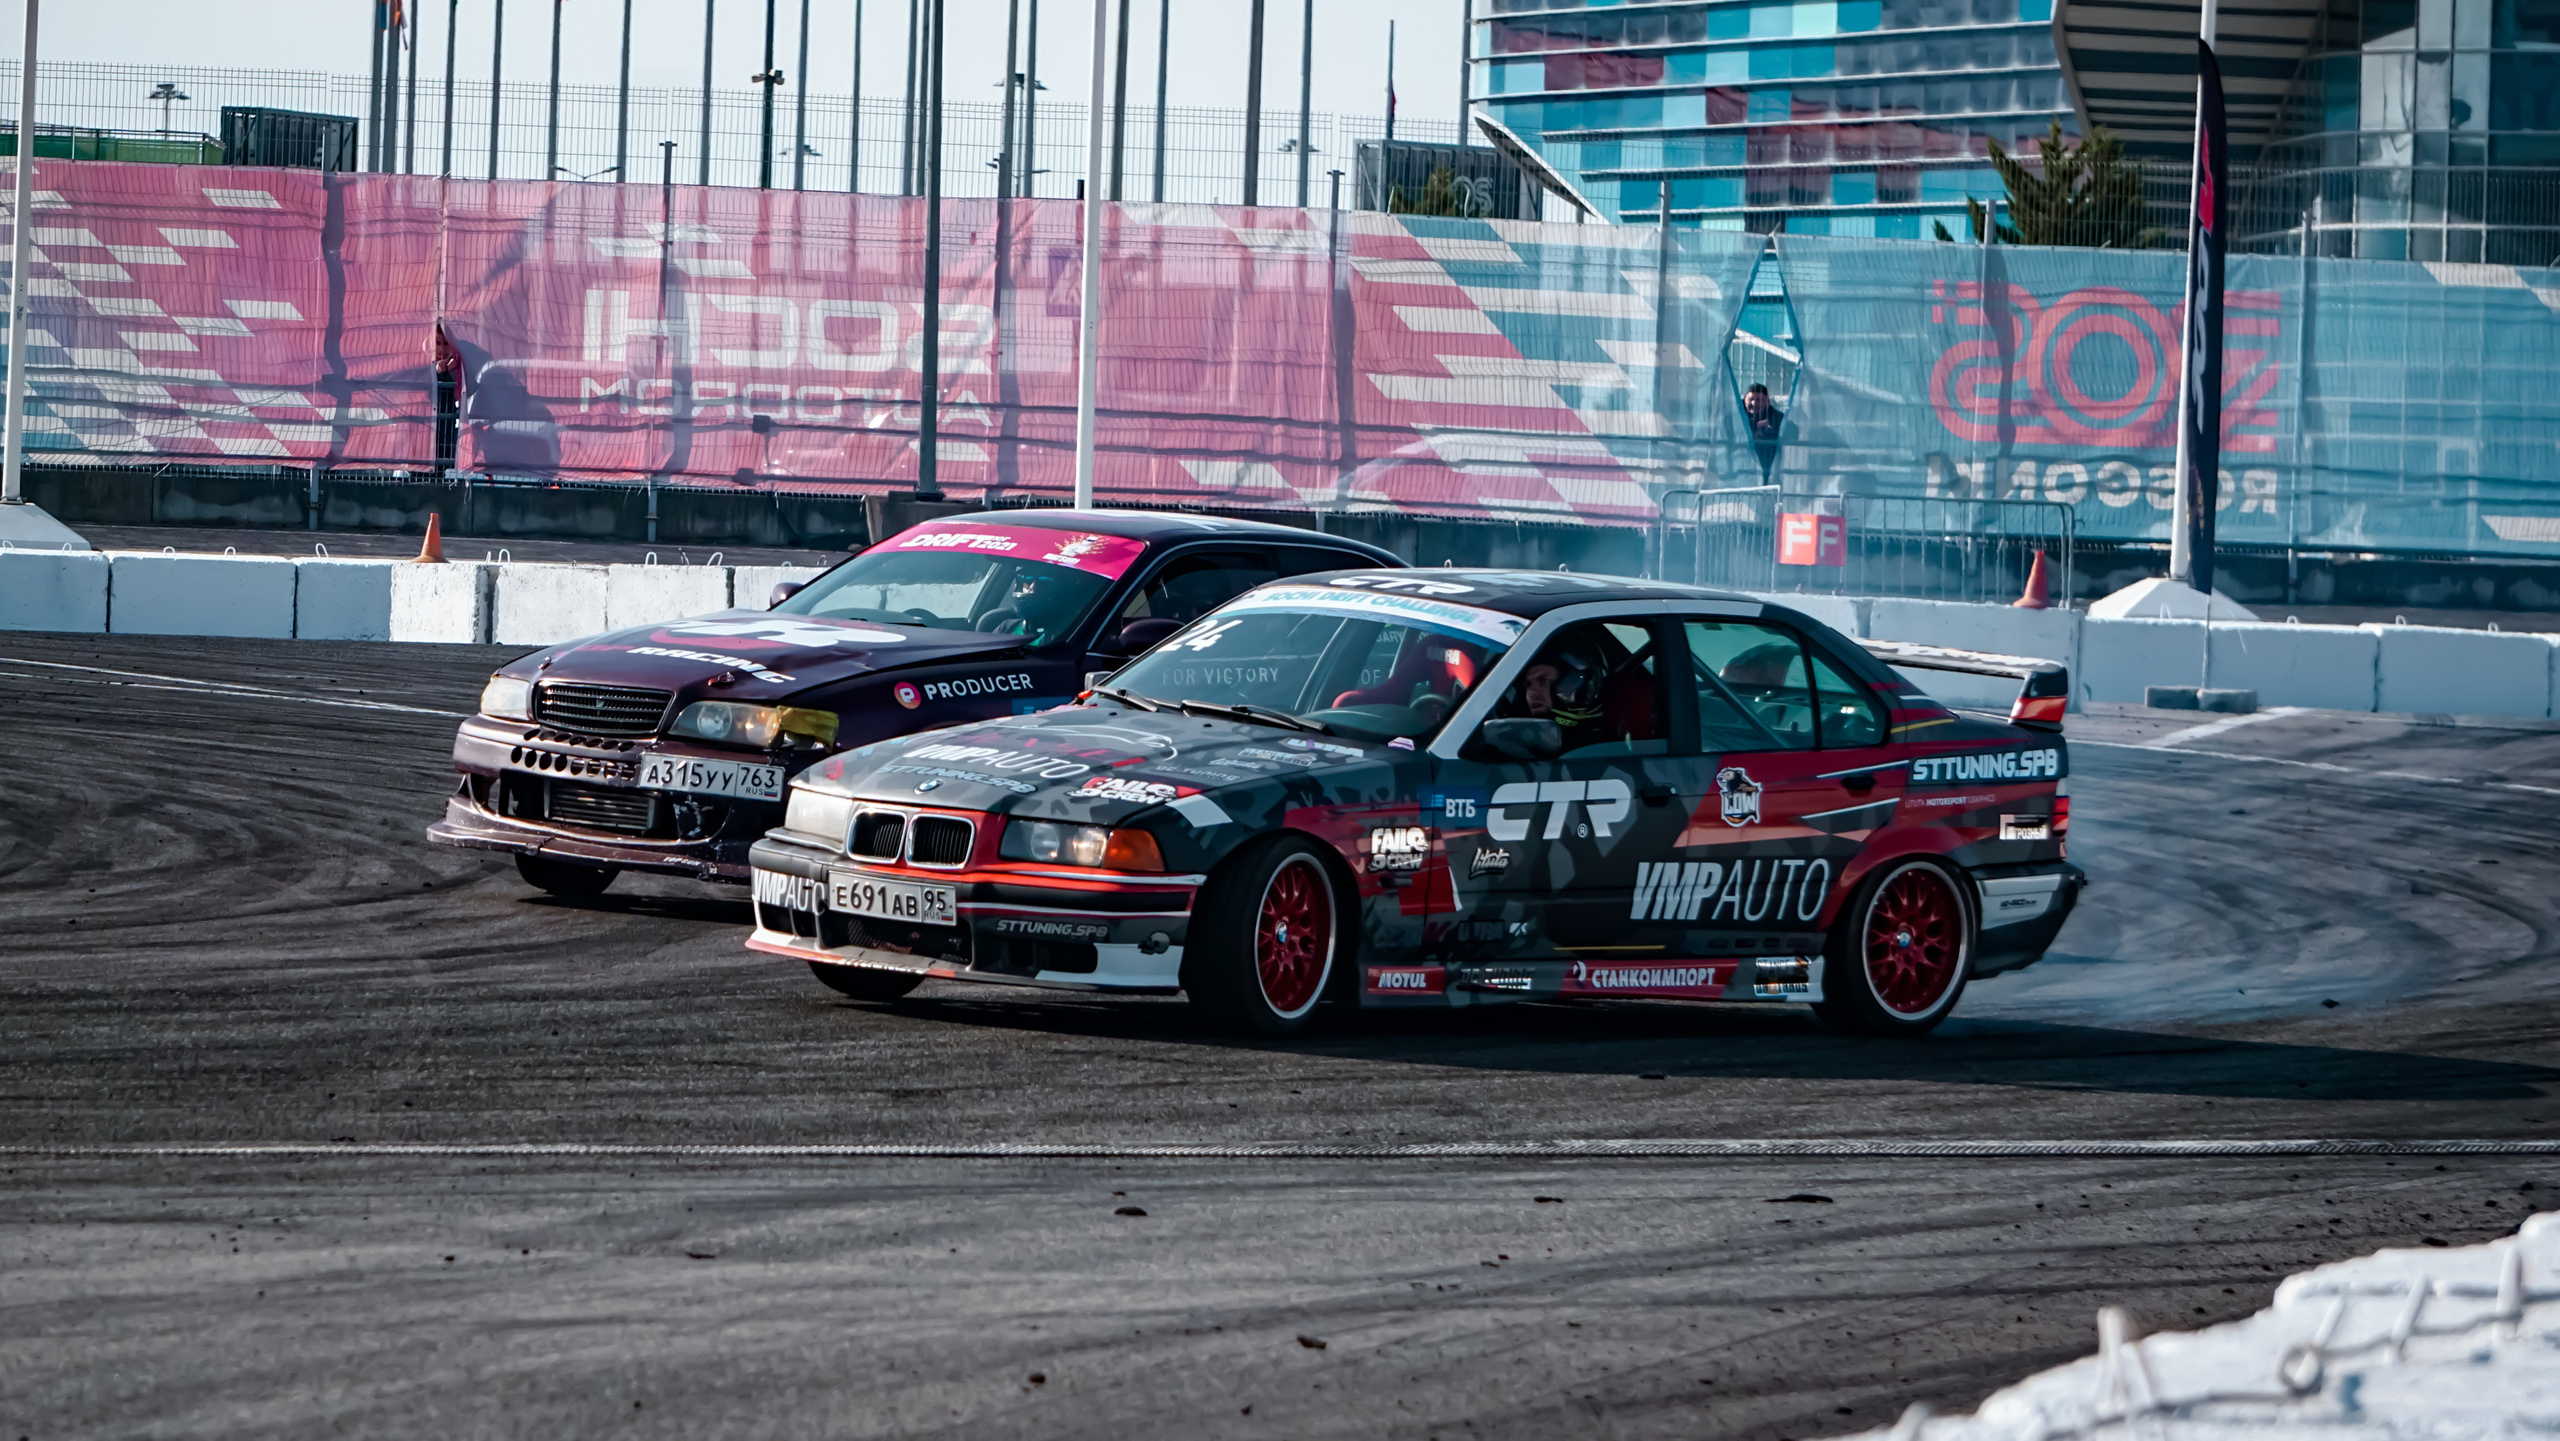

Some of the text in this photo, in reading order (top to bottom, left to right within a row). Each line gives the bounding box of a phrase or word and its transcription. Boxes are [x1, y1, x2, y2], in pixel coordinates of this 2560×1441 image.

[977, 540, 1018, 551] 2021
[1263, 590, 1481, 623] SOCHI DRIFT CHALLENGE
[627, 646, 796, 684] RACING
[923, 673, 1034, 701] PRODUCER
[1163, 668, 1196, 686] FOR
[1203, 667, 1279, 685] VICTORY
[905, 743, 1090, 779] VMPAUTO
[1912, 748, 2058, 781] STTUNING.SPB
[740, 766, 776, 788] 763
[876, 765, 1037, 794] STTUNING.SPB
[746, 786, 764, 796] RUS
[1101, 789, 1164, 805] CREW
[1445, 798, 1476, 818] ВТБ
[1486, 779, 1631, 842] CTR
[1371, 827, 1408, 853] FAIL
[1387, 853, 1423, 870] CREW
[923, 887, 947, 912] 95
[1629, 857, 1832, 923] VMPAUTO
[923, 910, 941, 920] RUS
[996, 919, 1108, 938] STTUNING.SPB
[1378, 972, 1427, 988] MOTUL
[1592, 967, 1715, 988] СТАНКОИМПОРТ
